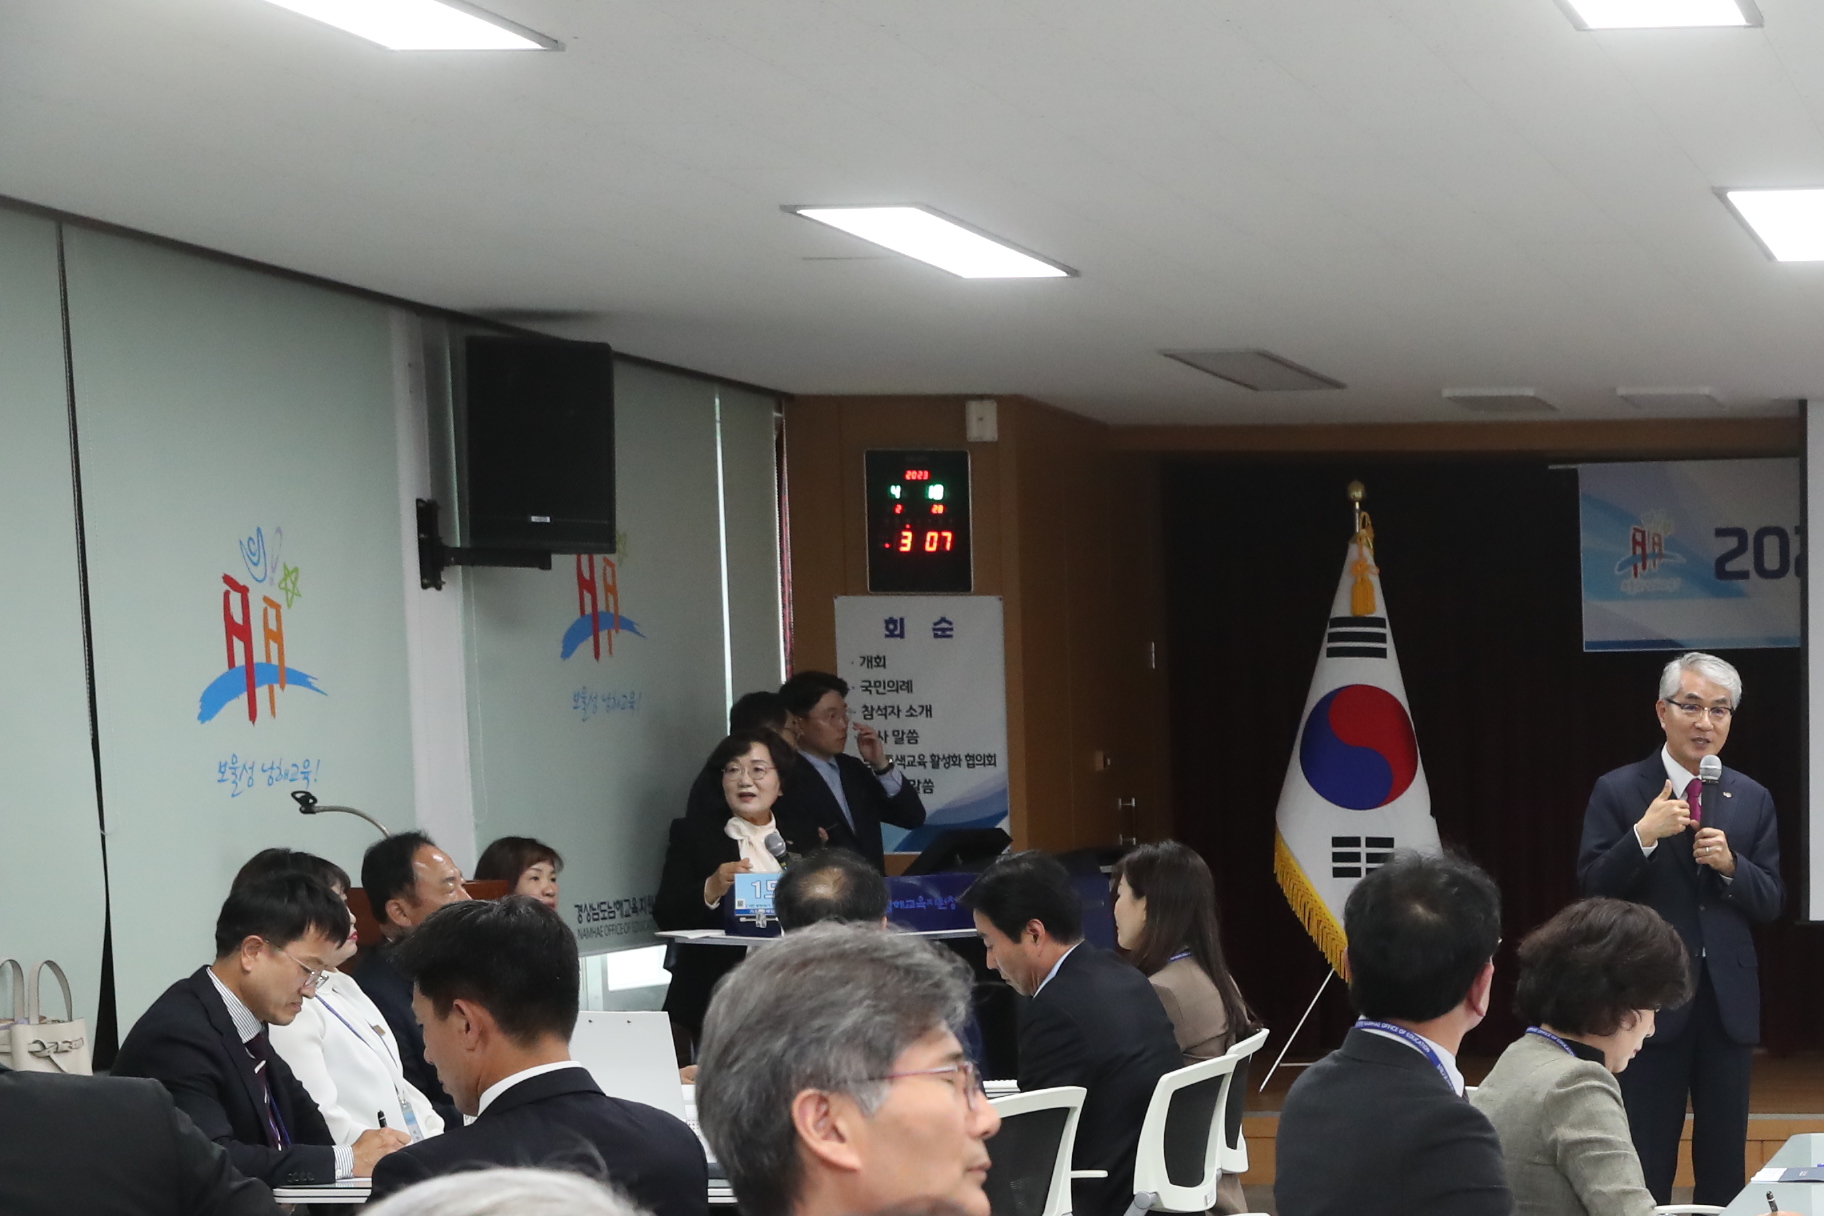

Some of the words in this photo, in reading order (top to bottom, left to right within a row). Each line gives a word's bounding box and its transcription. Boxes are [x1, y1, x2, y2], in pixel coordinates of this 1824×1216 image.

[905, 470, 930, 480] 2023
[890, 485, 901, 499] 4
[899, 531, 913, 551] 3
[925, 531, 952, 551] 07
[1714, 526, 1801, 580] 20
[859, 655, 887, 669] 개회
[860, 679, 913, 694] 국민의례
[861, 704, 901, 720] 참석자
[905, 704, 933, 718] 소개
[892, 729, 919, 745] 말씀
[930, 753, 962, 769] 활성화
[965, 753, 997, 769] 협의회
[1381, 1022, 1399, 1033] OFFICE
[1406, 1031, 1431, 1053] EDUCATION
